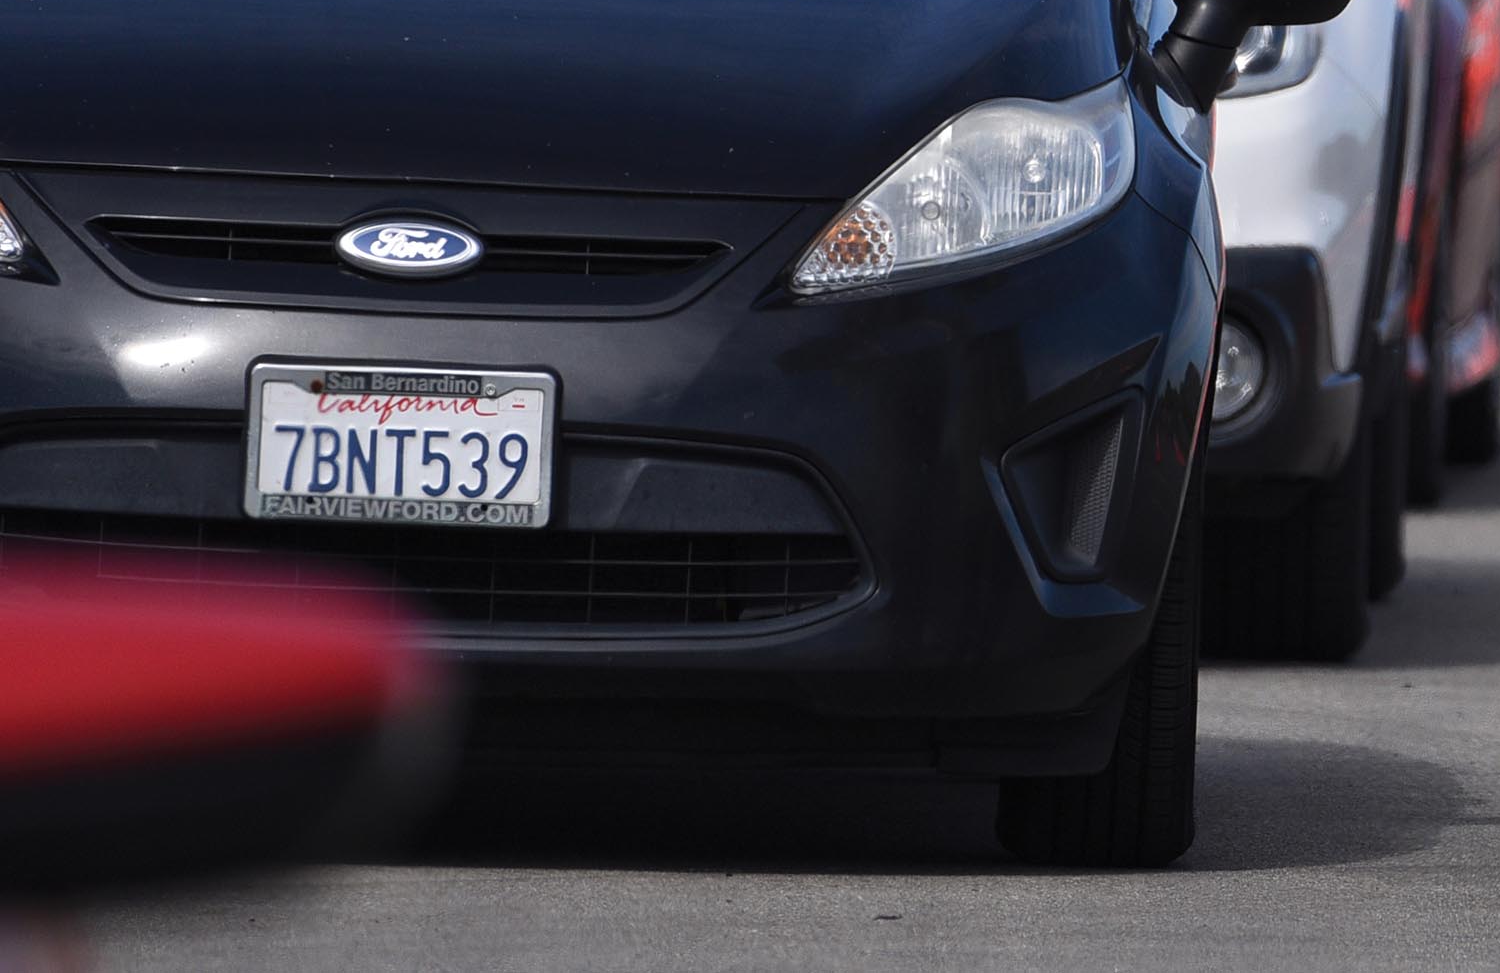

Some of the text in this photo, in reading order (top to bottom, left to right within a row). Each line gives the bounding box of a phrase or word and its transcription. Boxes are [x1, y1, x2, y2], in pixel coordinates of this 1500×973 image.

[371, 228, 447, 259] Ford
[326, 372, 479, 394] San Bernardino
[317, 393, 498, 425] California
[275, 425, 529, 500] 7BNT539
[265, 495, 530, 524] FAIRVIEWFORD.COM
